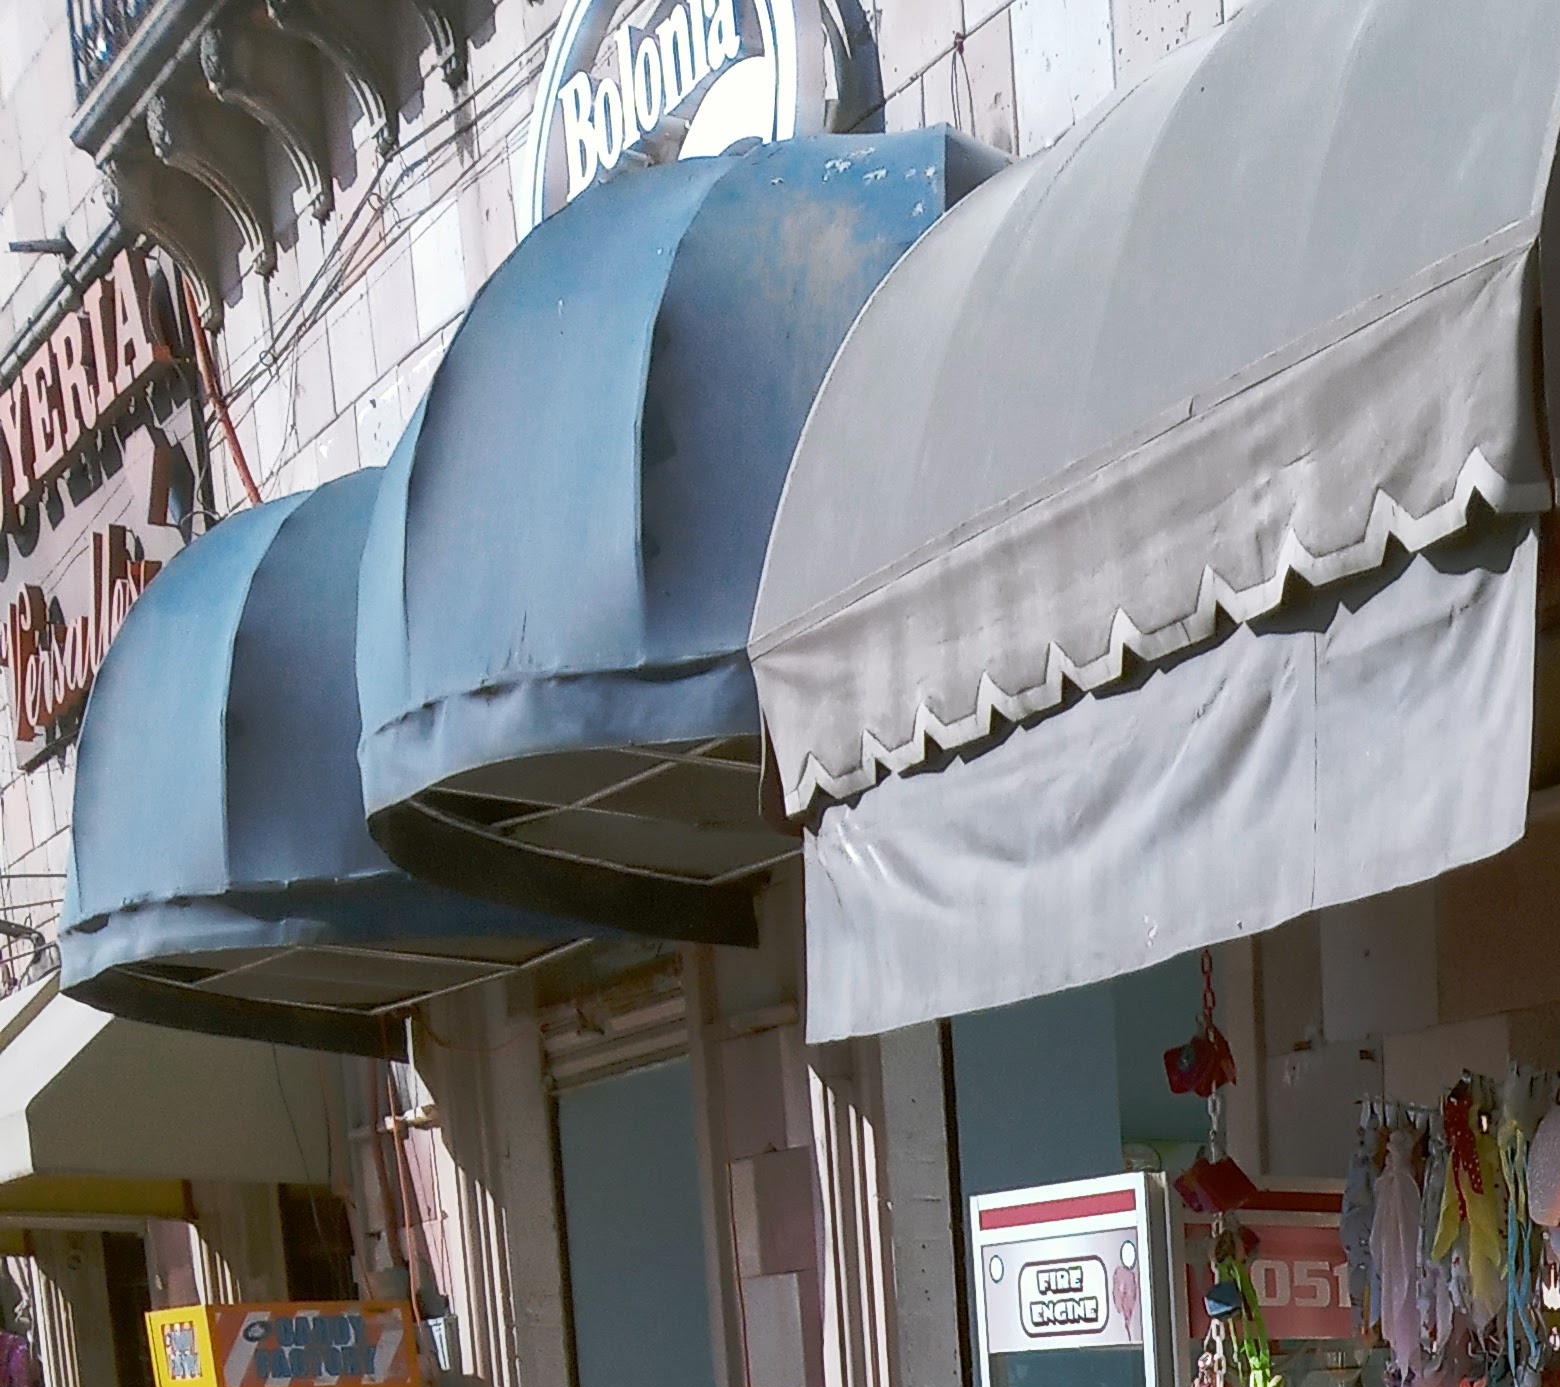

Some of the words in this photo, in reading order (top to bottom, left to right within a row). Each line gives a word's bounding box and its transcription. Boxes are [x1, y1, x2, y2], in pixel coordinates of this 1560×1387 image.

[1036, 1266, 1084, 1295] FIRE
[1030, 1296, 1099, 1327] ENGINE
[275, 1314, 363, 1347] CANDY
[255, 1345, 377, 1379] FACTORY
